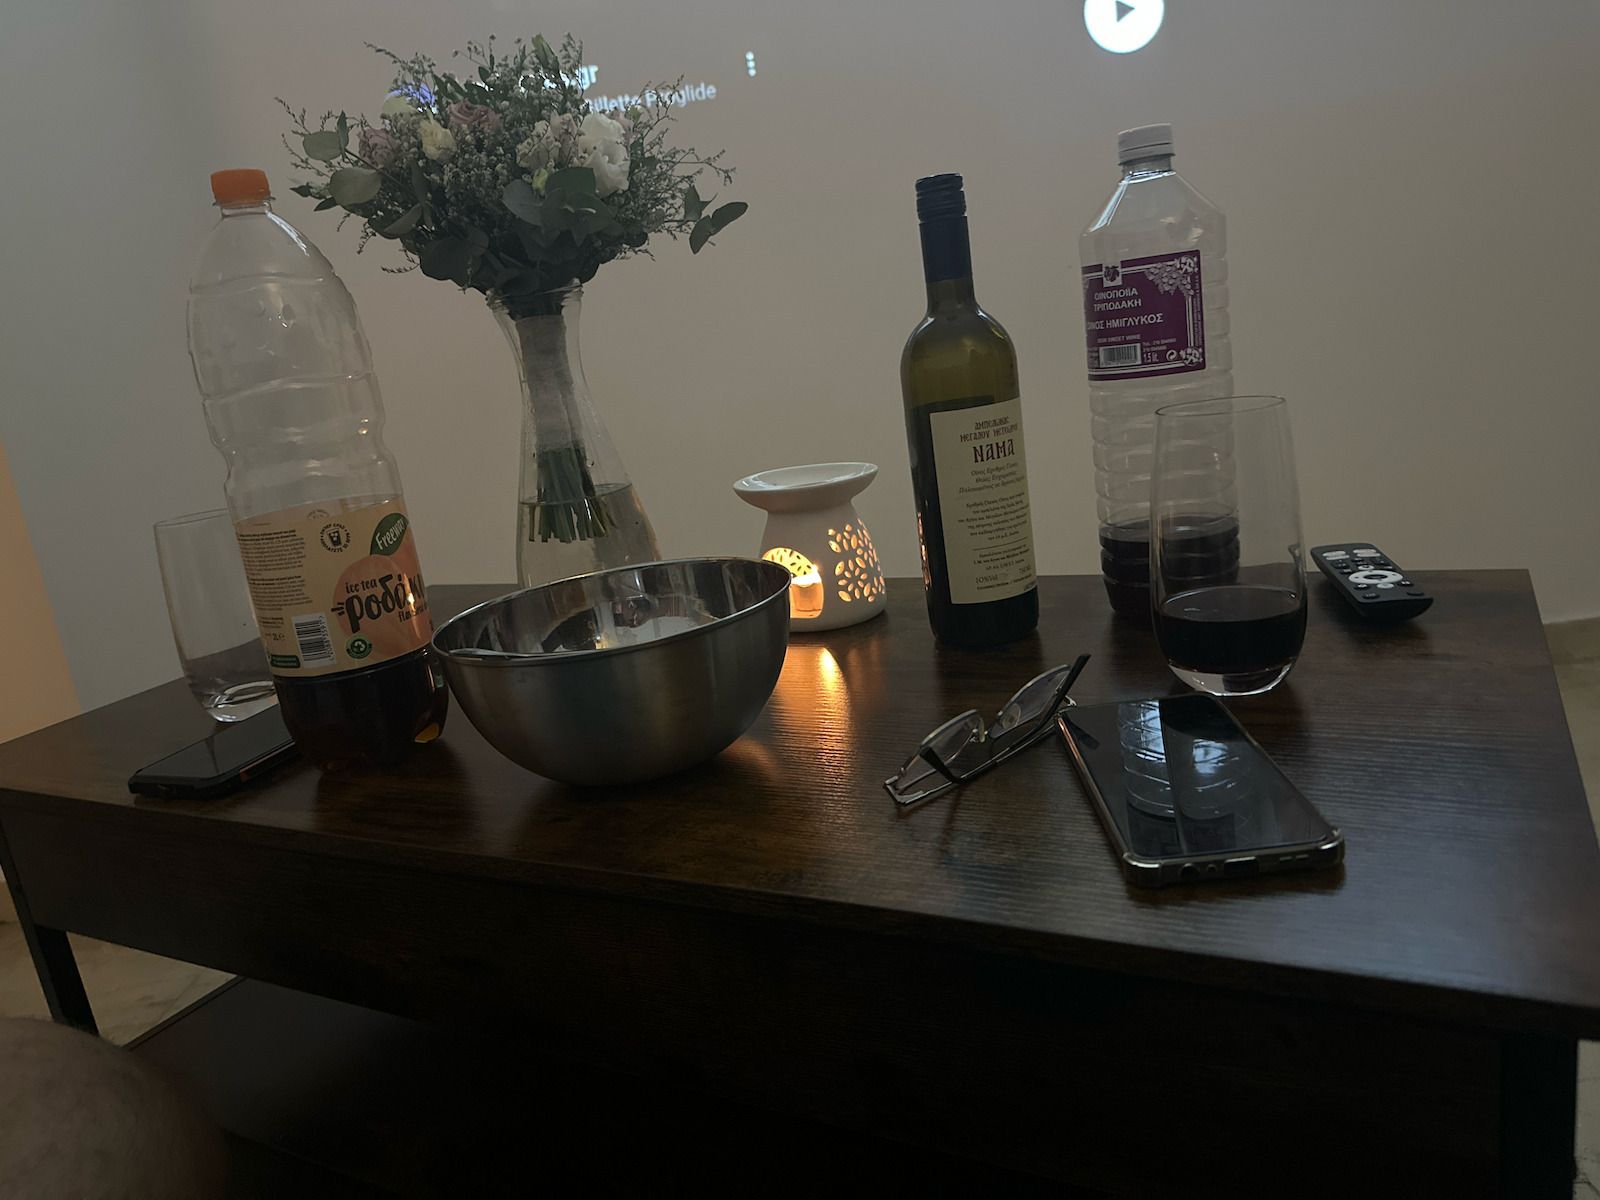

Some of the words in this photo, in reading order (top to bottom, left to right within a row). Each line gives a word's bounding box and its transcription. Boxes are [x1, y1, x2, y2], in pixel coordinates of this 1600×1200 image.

[1093, 298, 1142, 312] ΤΡΙΠΟΔΑΚΗ
[1105, 313, 1164, 330] ΗΜΙΓΛΥΚΟΣ
[374, 517, 405, 551] Freeway
[345, 582, 360, 594] ice
[361, 579, 378, 592] tea
